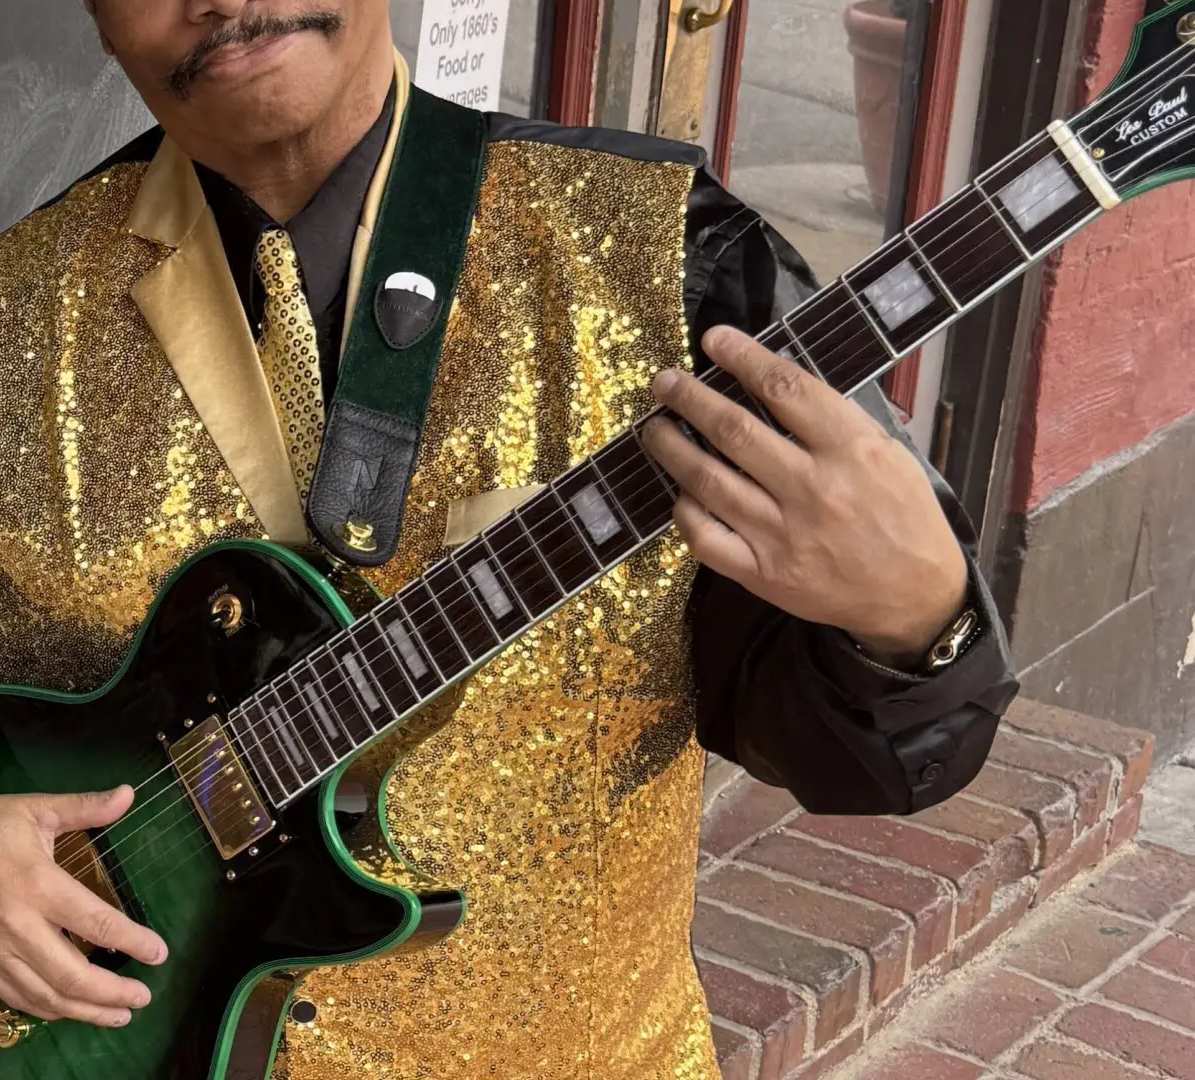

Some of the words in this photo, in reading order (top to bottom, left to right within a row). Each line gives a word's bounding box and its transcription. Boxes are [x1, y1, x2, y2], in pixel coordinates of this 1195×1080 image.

[429, 18, 457, 48] Only
[461, 12, 498, 40] 1860's
[436, 51, 469, 79] Food
[470, 52, 484, 71] or
[1148, 86, 1188, 120] Paul
[1130, 106, 1188, 145] CUSTOM
